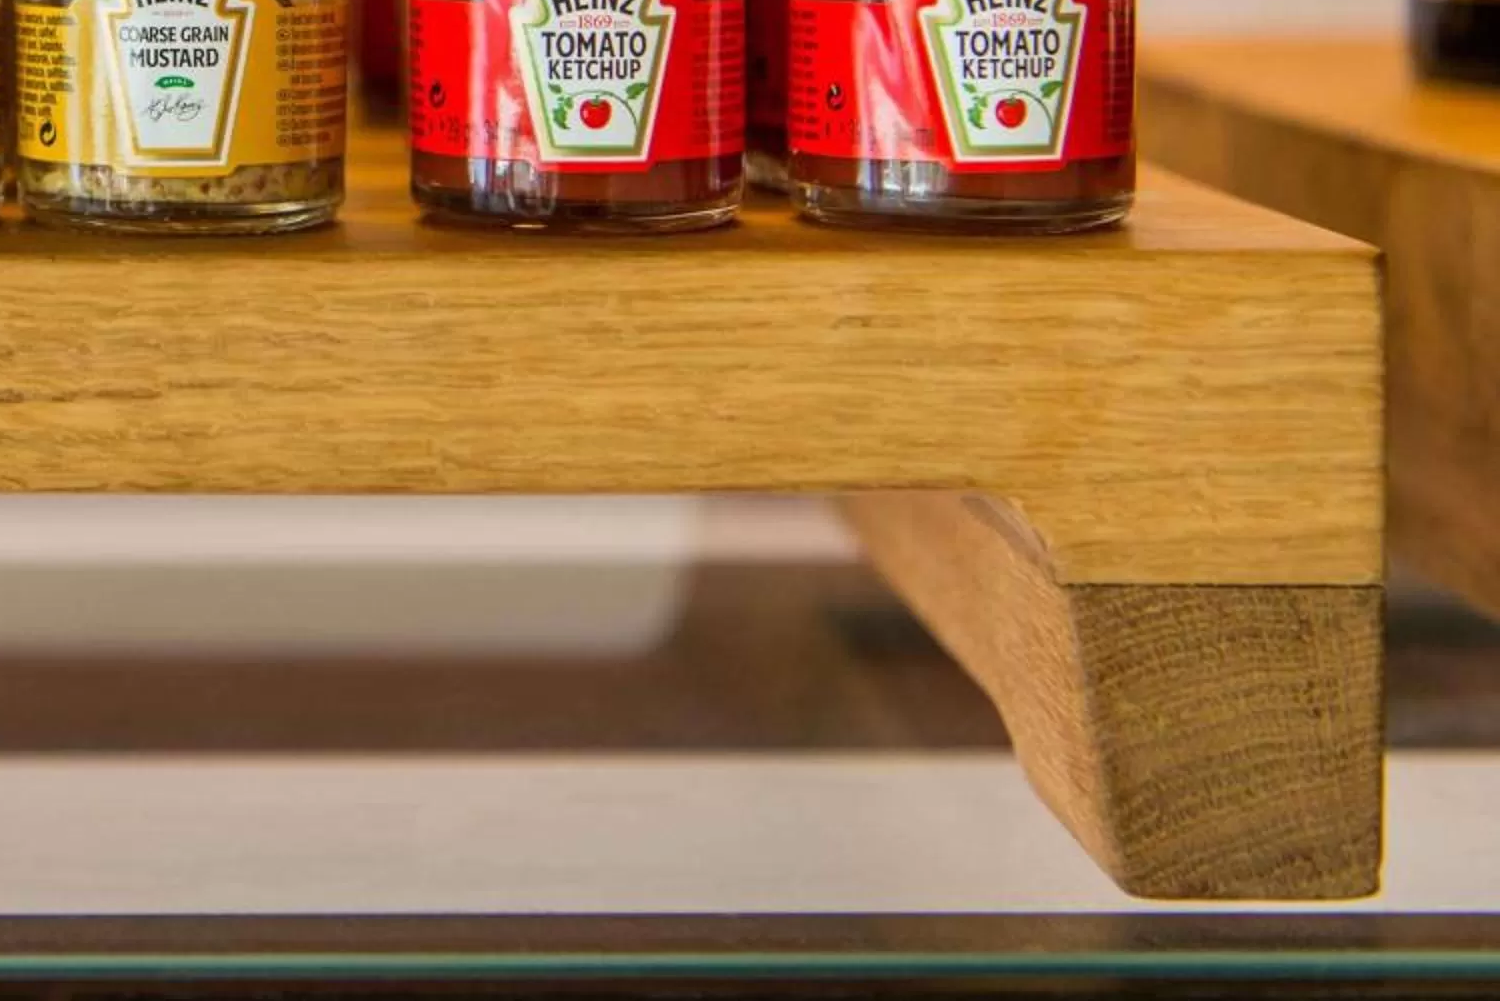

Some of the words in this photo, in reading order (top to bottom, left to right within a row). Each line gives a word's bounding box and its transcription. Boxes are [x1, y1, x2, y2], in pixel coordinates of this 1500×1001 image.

[577, 14, 613, 29] 1869
[119, 25, 177, 43] COARSE
[180, 25, 229, 43] GRAIN
[541, 30, 647, 58] TOMATO
[955, 29, 1061, 57] TOMATO
[129, 48, 220, 68] MUSTARD
[962, 58, 1055, 79] KETCHUP
[547, 59, 642, 81] KETCHUP
